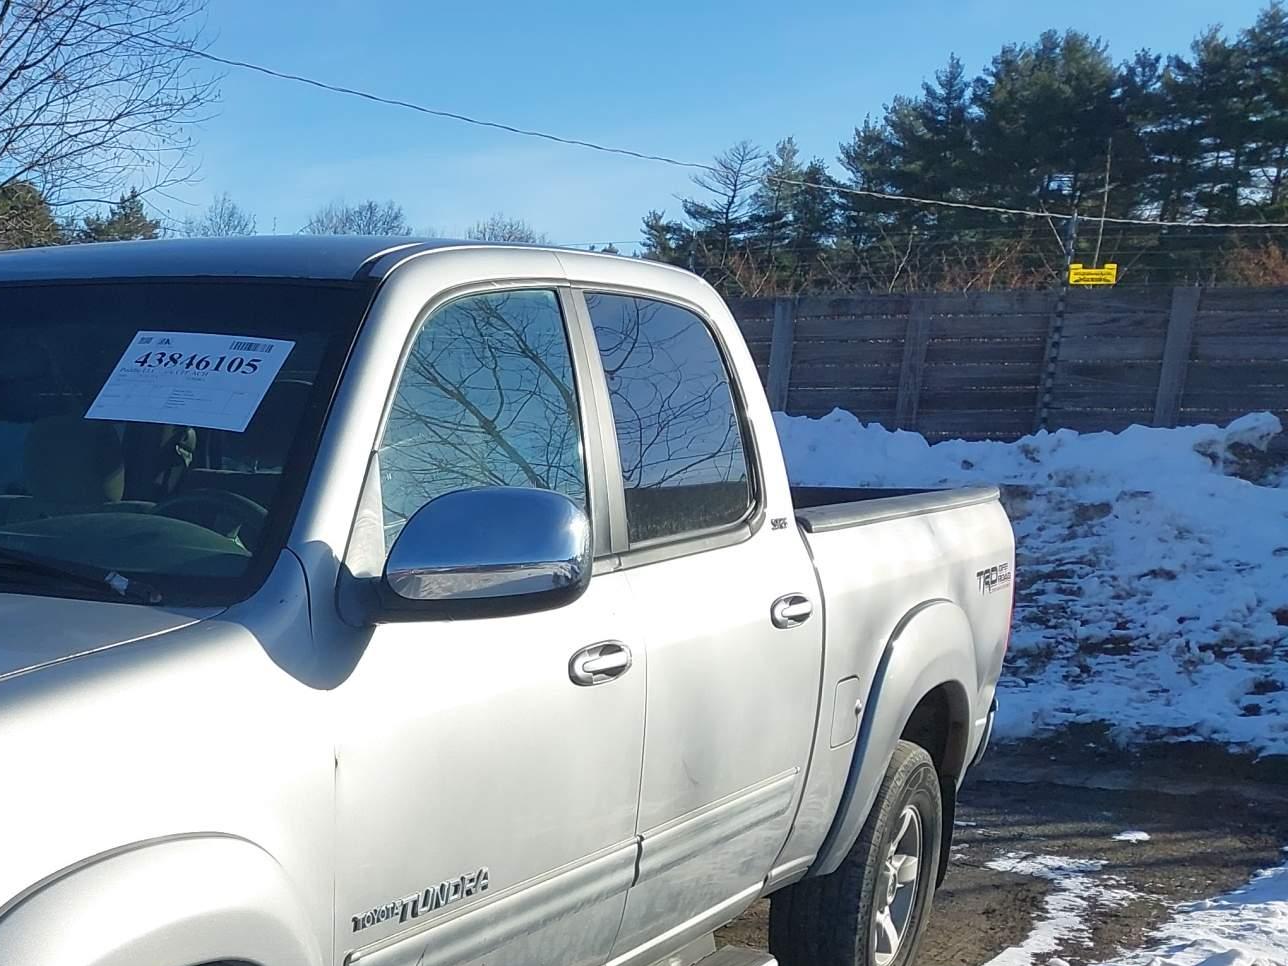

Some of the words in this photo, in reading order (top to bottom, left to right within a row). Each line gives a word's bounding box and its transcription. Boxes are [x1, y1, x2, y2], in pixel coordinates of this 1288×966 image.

[134, 351, 263, 375] 43846105
[976, 565, 998, 596] TRD
[351, 898, 402, 932] TOYOTA
[399, 866, 489, 923] TUNDRA
